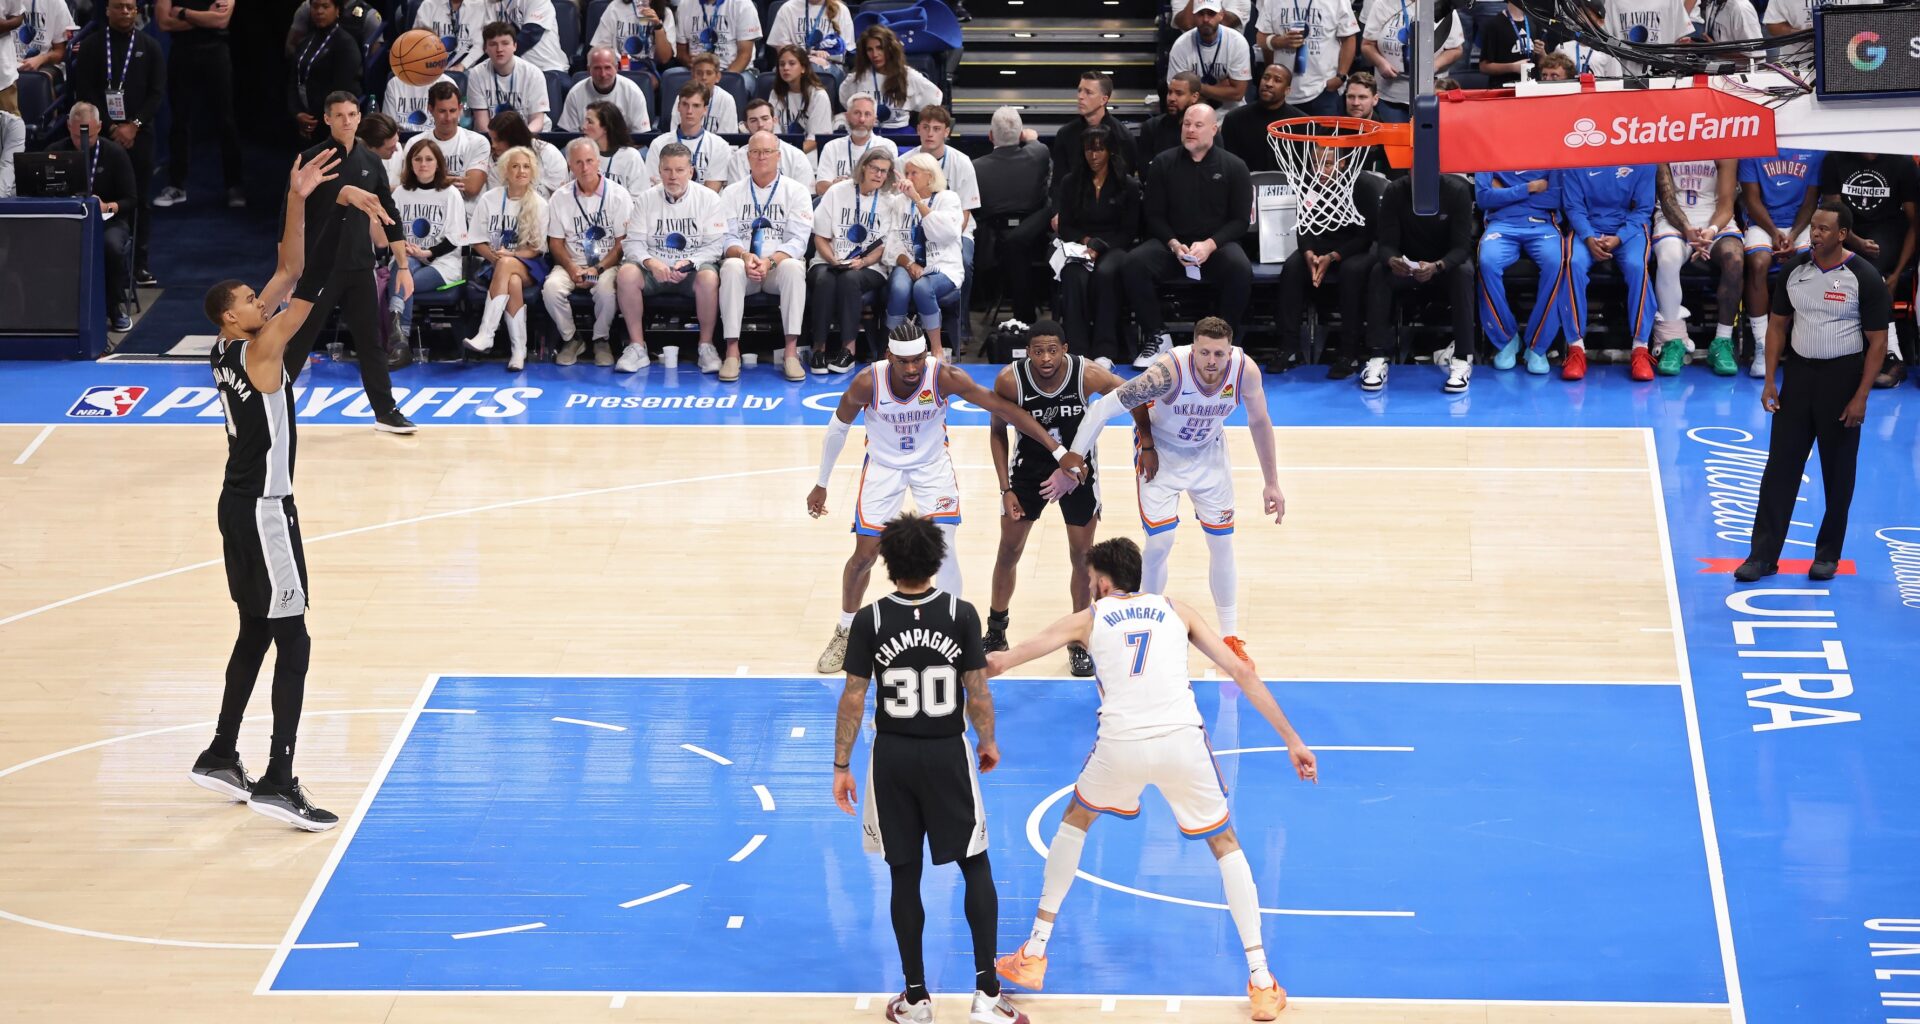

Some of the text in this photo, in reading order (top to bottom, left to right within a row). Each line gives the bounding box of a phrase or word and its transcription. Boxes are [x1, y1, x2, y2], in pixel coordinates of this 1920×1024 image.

[1619, 11, 1661, 28] PLAYOFFS
[1312, 27, 1321, 38] 26
[1671, 164, 1716, 179] KLAHOMA
[1762, 161, 1808, 178] THUNDER
[1680, 178, 1703, 190] CITY
[1846, 186, 1886, 196] THUNDER
[1686, 191, 1697, 206] 6
[402, 203, 444, 222] PLAYOFFS
[655, 217, 699, 236] PLAYOFFS
[565, 393, 742, 409] Presented
[743, 396, 784, 411] by
[1186, 417, 1215, 428] CITY
[901, 436, 915, 450] 2
[1177, 427, 1211, 442] 55
[1103, 606, 1166, 628] HOLMGREN
[874, 628, 963, 667] CHAMPAGNIE
[1123, 629, 1152, 678] 7
[1725, 588, 1862, 733] ULTRA
[881, 664, 958, 719] 30
